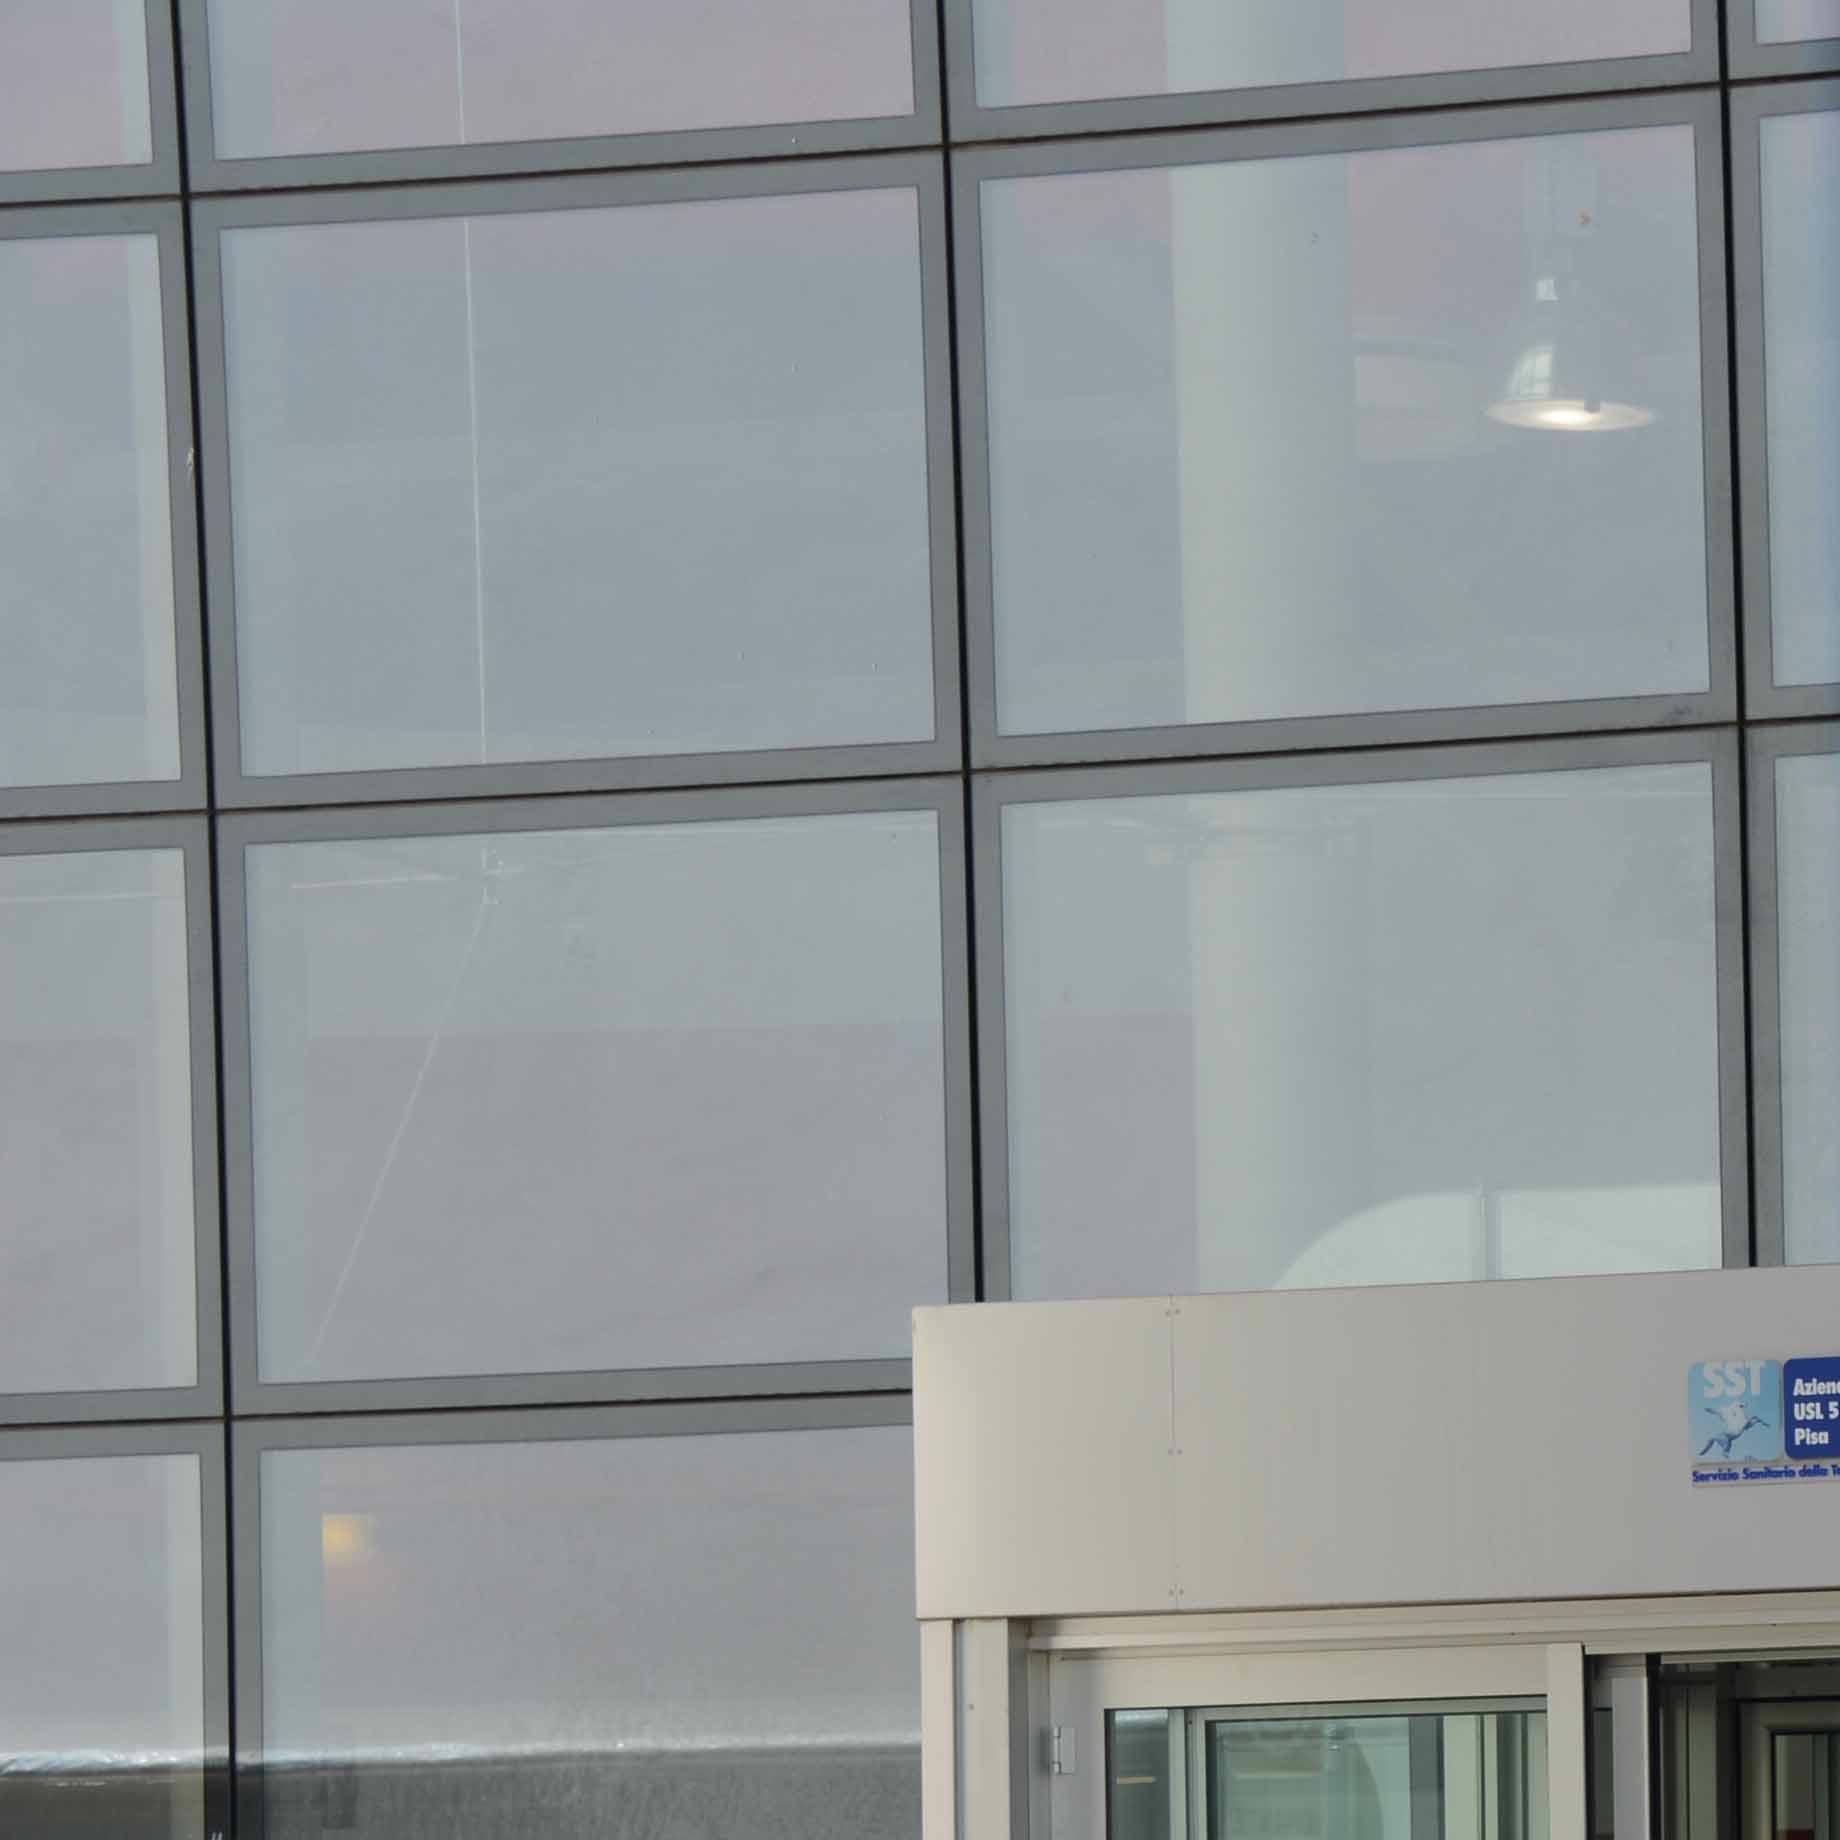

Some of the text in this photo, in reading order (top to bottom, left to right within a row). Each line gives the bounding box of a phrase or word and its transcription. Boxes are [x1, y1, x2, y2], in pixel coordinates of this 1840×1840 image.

[1702, 1359, 1767, 1400] SST
[1793, 1401, 1840, 1421] USL 5
[1793, 1427, 1830, 1446] Pisa
[1692, 1468, 1740, 1483] Servizio
[1742, 1466, 1796, 1481] Sanitario
[1798, 1465, 1829, 1478] della
